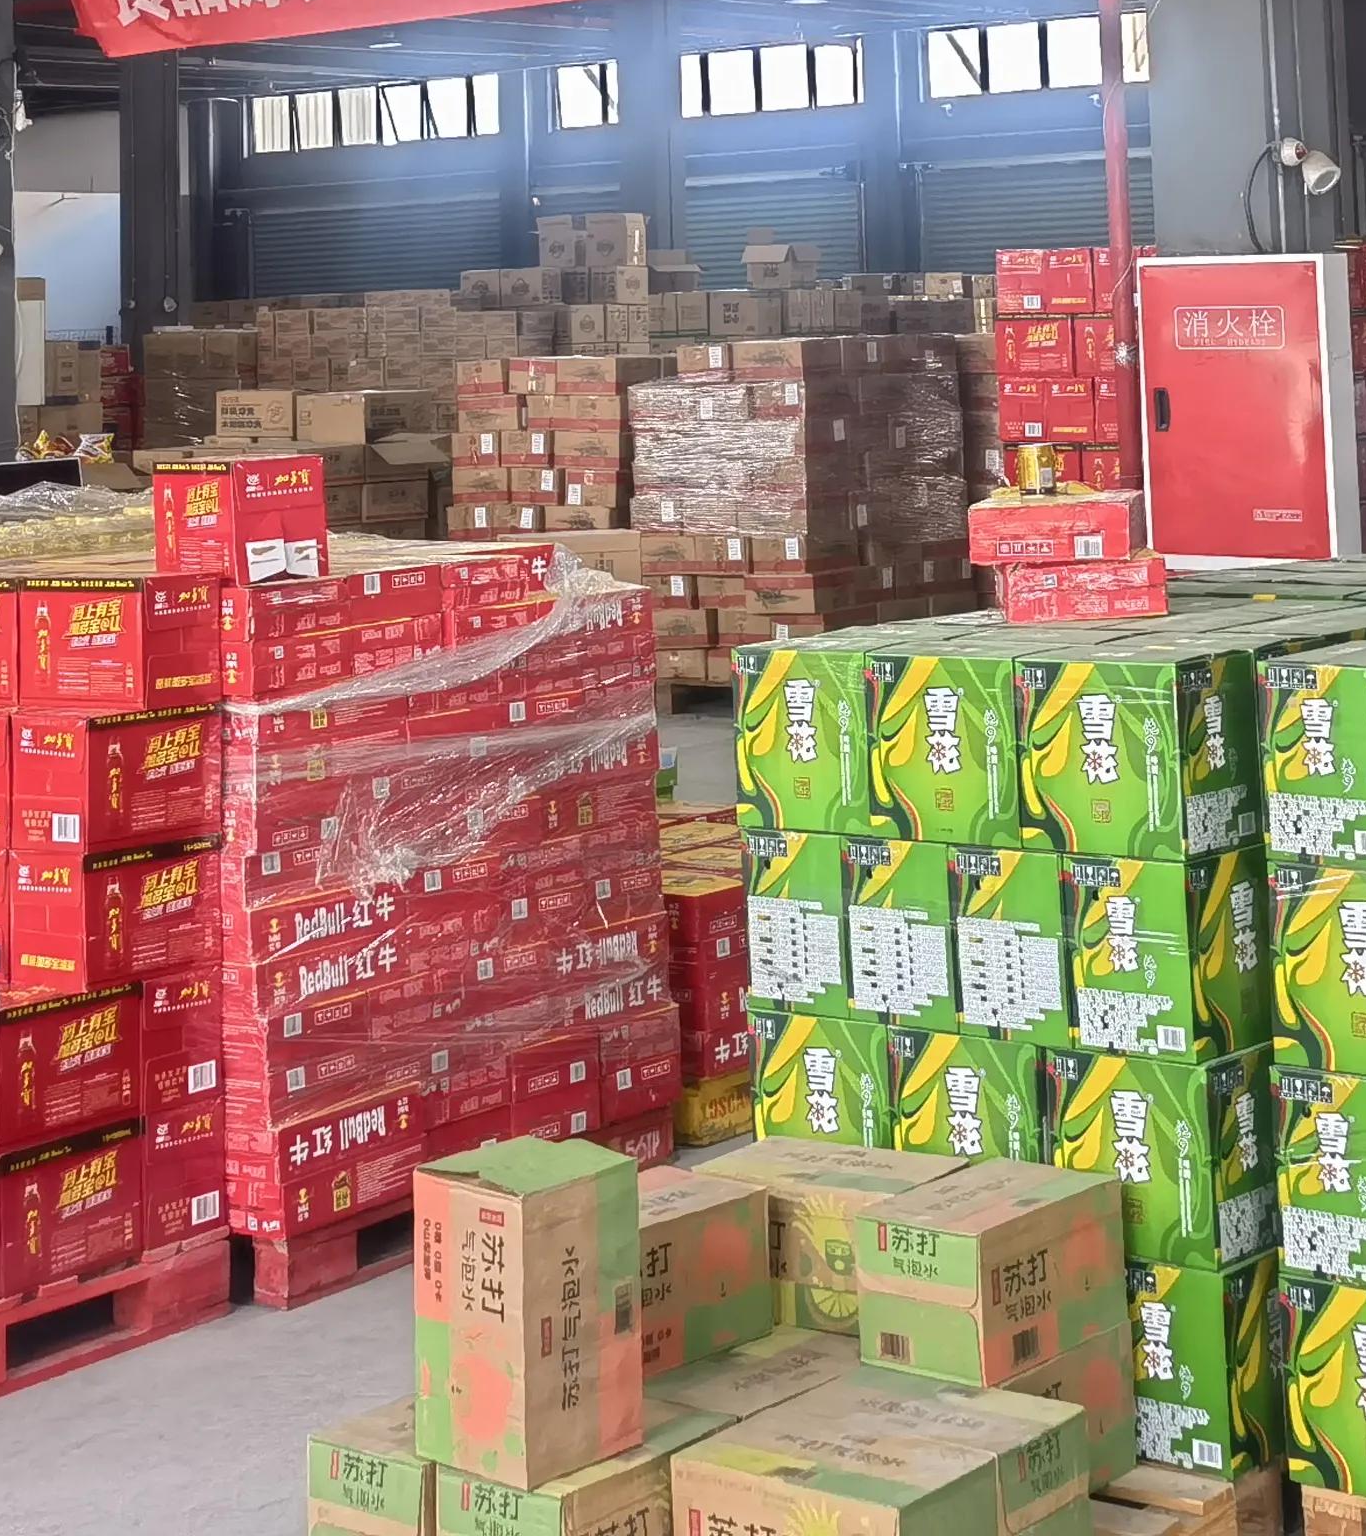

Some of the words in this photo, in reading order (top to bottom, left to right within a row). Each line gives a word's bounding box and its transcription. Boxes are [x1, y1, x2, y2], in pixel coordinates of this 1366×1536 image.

[1183, 309, 1277, 339] 消火栓
[781, 677, 815, 764] 雪花
[921, 684, 961, 776] 雪花
[1075, 692, 1120, 786] 雪花
[1297, 696, 1335, 777] 雪花
[1105, 893, 1139, 974] 雪花
[801, 1045, 839, 1135] 雪花
[943, 1064, 985, 1158] 雪花
[1107, 1086, 1150, 1185] 雪花
[1313, 1110, 1353, 1195] 雪花
[461, 1230, 477, 1312] 气泡水
[481, 1232, 506, 1324] 苏打
[891, 1226, 939, 1258] 苏打
[892, 1256, 939, 1279] 气泡水
[1004, 1248, 1048, 1296] 苏打
[561, 1246, 582, 1411] 苏打气泡水
[1005, 1291, 1051, 1322] 气泡水
[1139, 1299, 1173, 1381] 雪花
[343, 1453, 388, 1488] 苏打
[474, 1484, 523, 1521] 苏打
